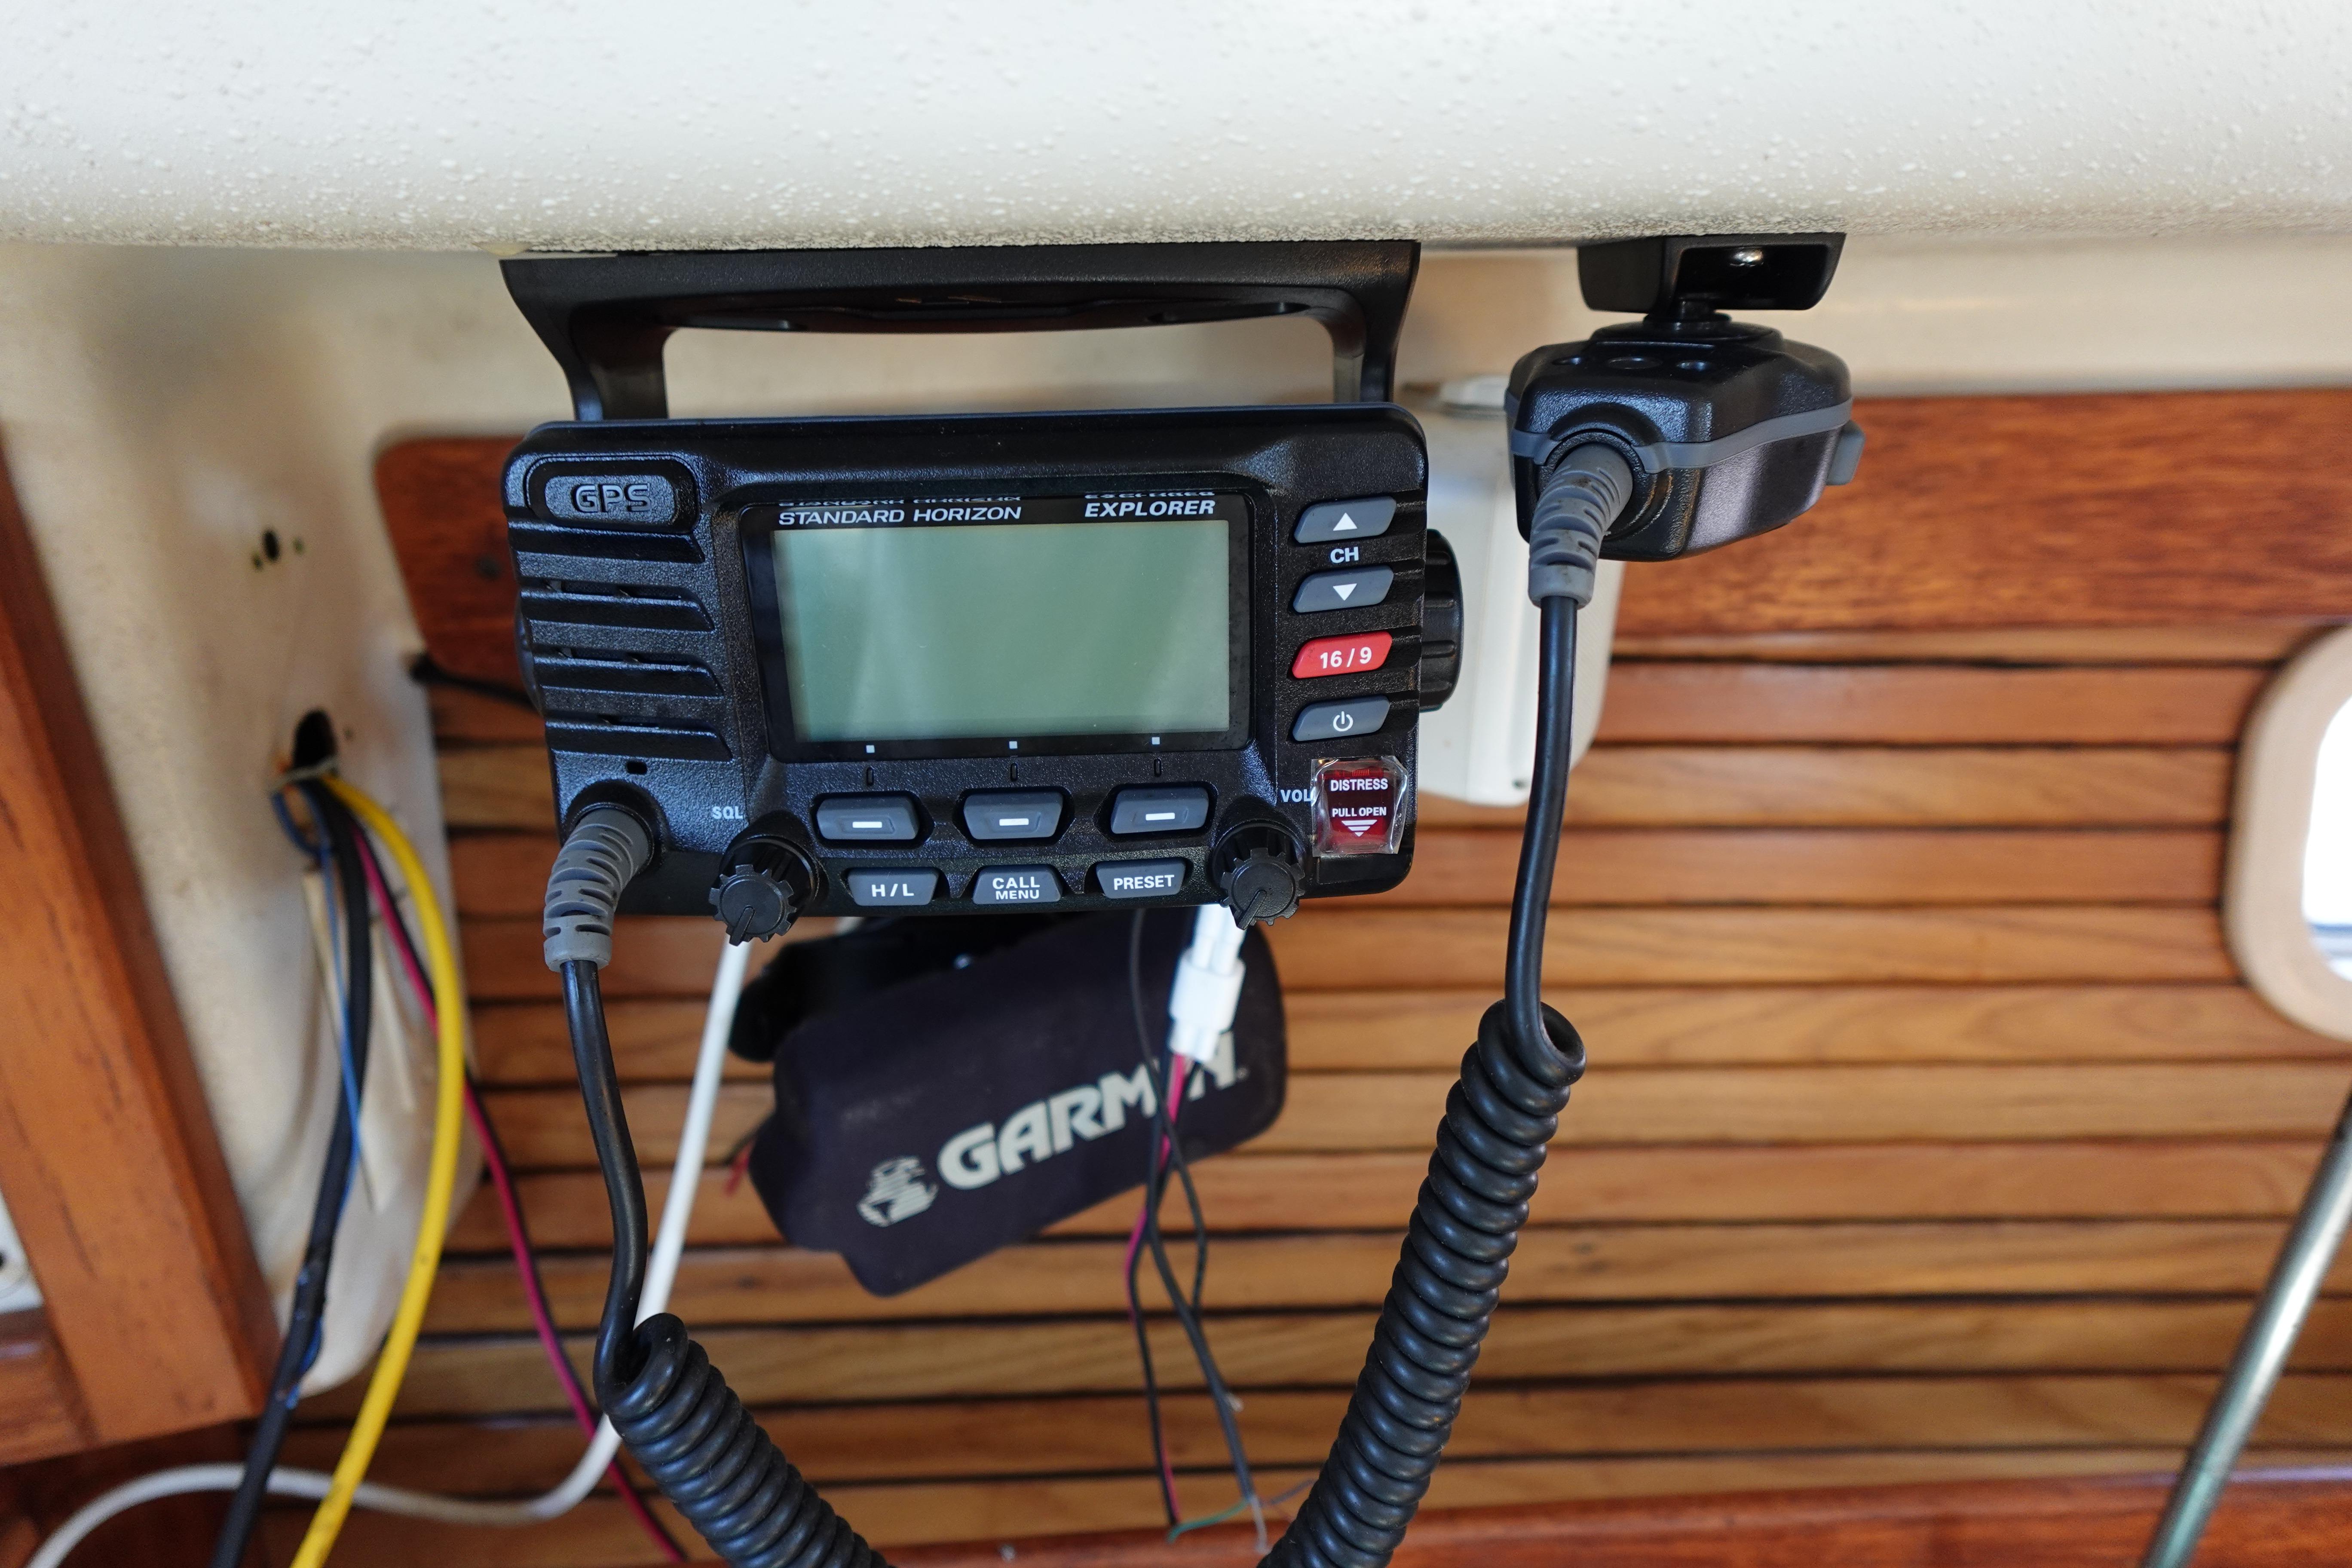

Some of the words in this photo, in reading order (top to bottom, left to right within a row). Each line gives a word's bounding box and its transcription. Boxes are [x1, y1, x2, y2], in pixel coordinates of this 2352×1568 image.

[574, 484, 652, 513] GPS
[778, 510, 905, 525] STANDARD
[913, 506, 1022, 522] HORIZON
[1084, 499, 1216, 517] EXPLORER
[1330, 546, 1359, 564] CH
[1330, 778, 1388, 791] DISTRESS
[1280, 789, 1313, 803] VOL
[712, 805, 744, 820] SQL
[1332, 808, 1357, 817] PULL
[1359, 806, 1387, 817] OPEN
[992, 876, 1040, 889] CALL
[1113, 874, 1175, 890] PRESET
[871, 883, 914, 897] H/L
[995, 890, 1040, 900] MENU
[937, 1030, 1237, 1189] GARMN
